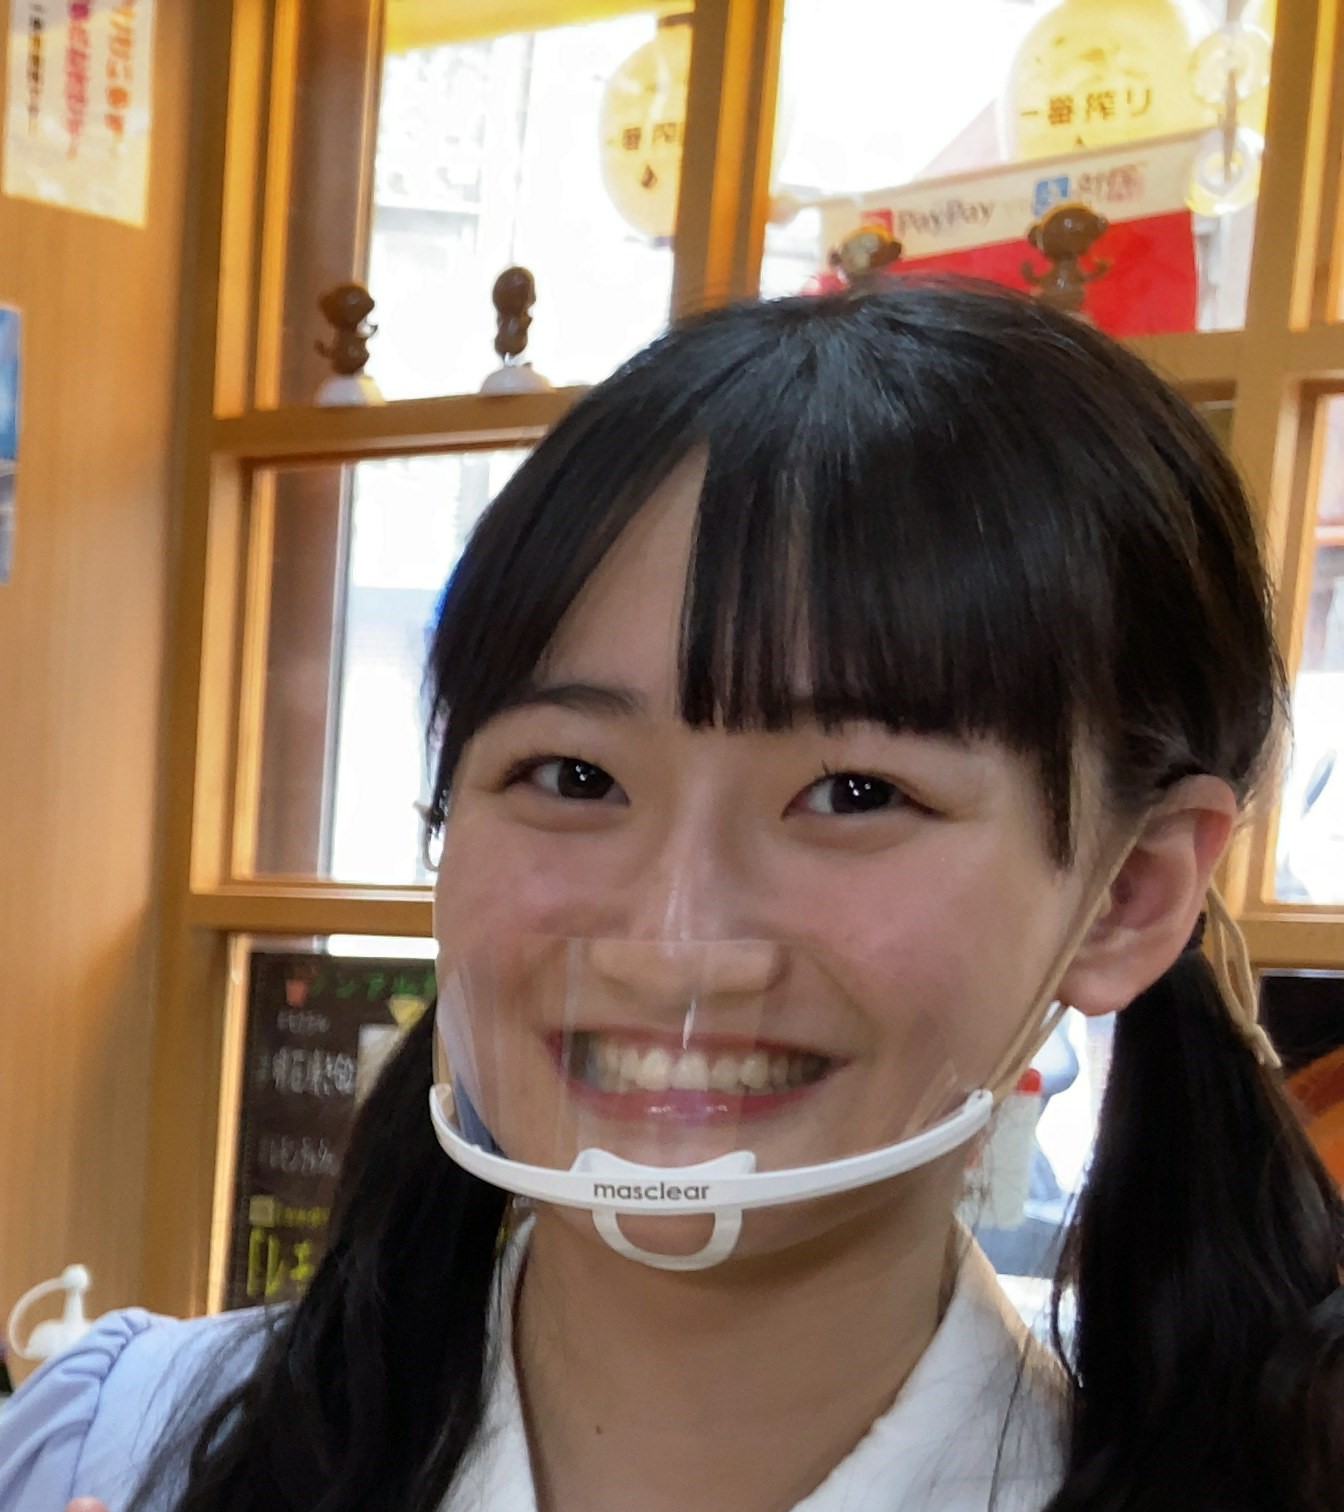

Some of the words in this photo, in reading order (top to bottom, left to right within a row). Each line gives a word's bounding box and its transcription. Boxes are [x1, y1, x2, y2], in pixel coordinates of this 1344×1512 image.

[606, 122, 684, 150] 一番搾
[898, 199, 995, 237] PayPay
[593, 1181, 710, 1200] masclear
